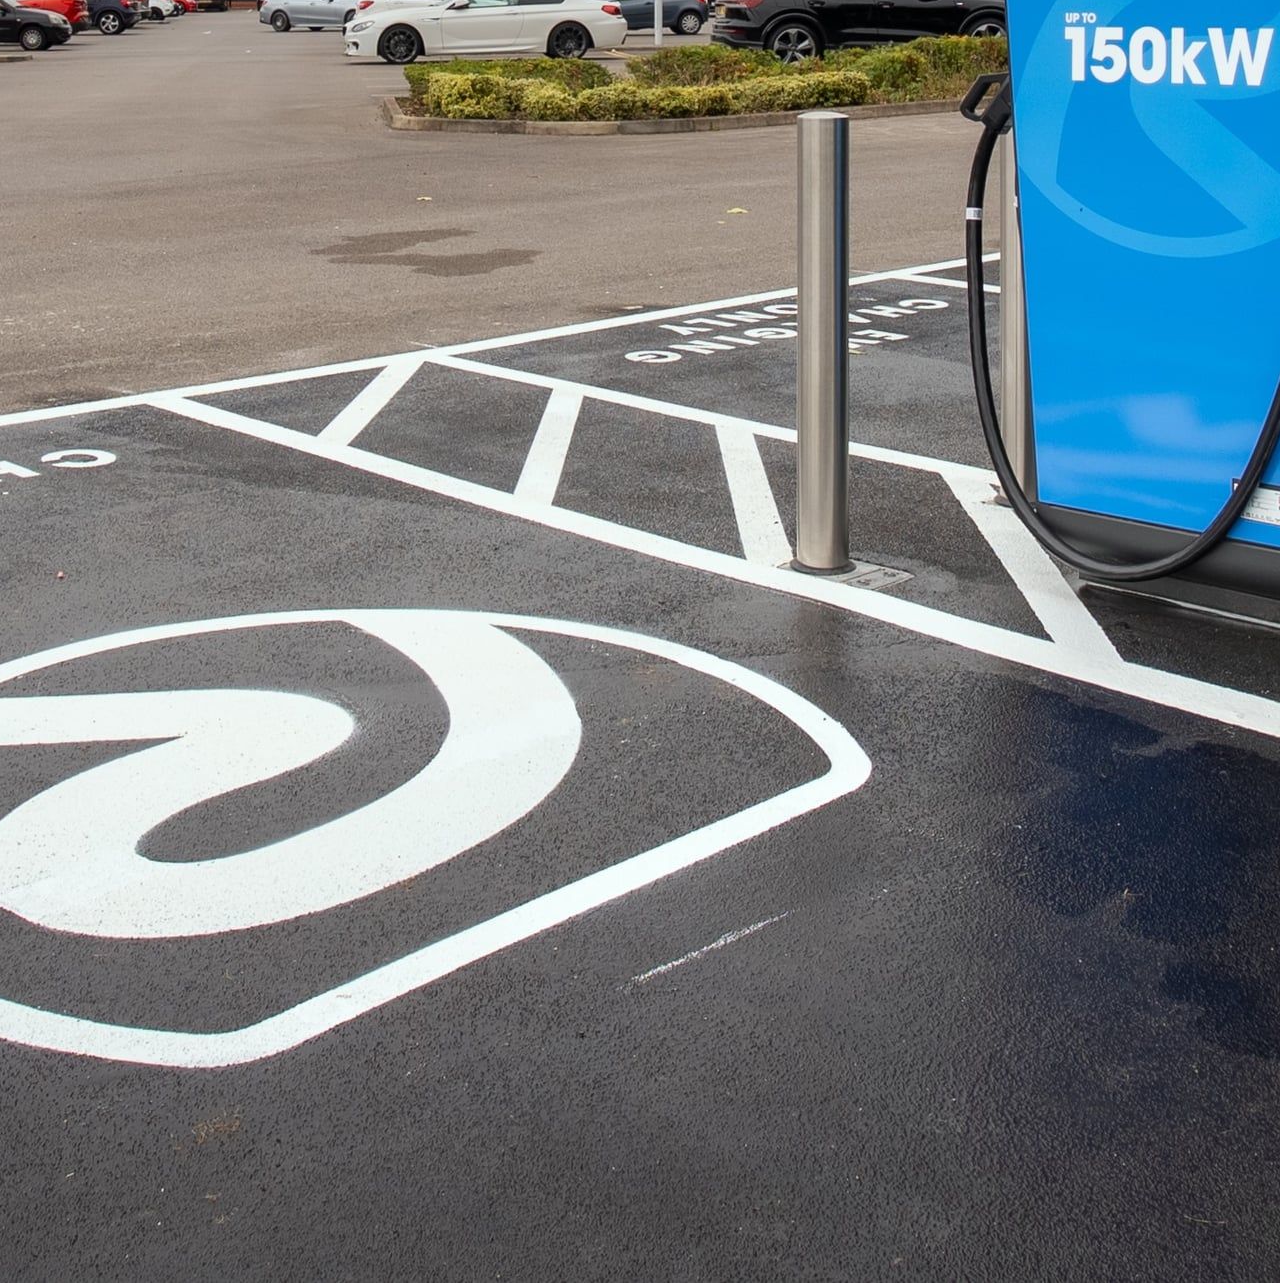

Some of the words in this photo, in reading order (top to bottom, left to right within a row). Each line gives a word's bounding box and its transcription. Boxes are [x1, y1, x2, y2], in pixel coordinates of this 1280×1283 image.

[1064, 12, 1080, 24] UP
[1082, 12, 1097, 24] TO
[1064, 26, 1275, 87] 150kW
